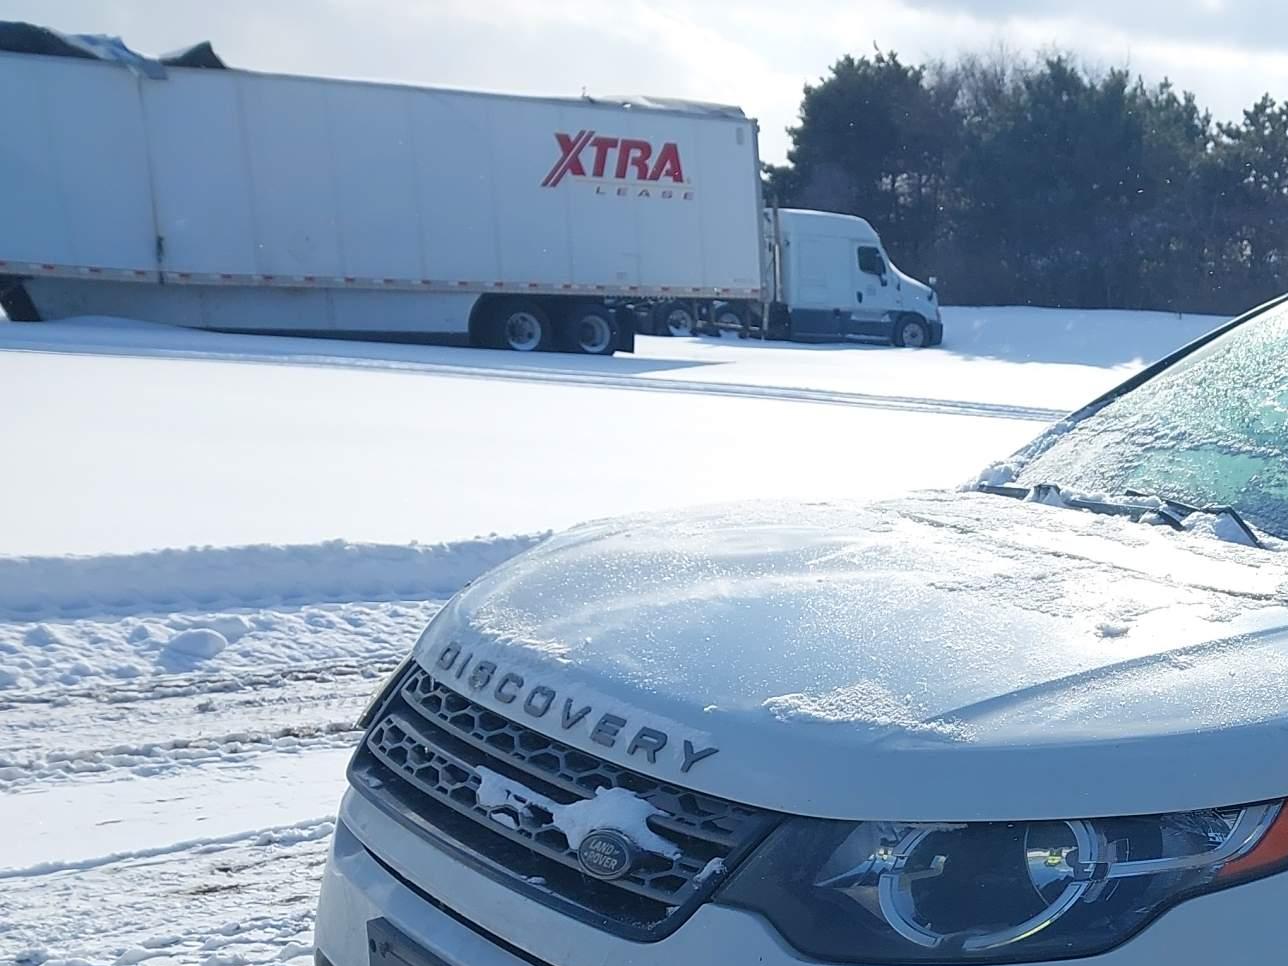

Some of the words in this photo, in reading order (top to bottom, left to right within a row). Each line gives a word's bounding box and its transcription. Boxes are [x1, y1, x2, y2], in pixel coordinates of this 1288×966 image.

[541, 129, 684, 187] XTRA
[595, 186, 695, 201] LEASE
[436, 641, 720, 774] DISCOVERY
[589, 839, 615, 856] LAND
[588, 850, 618, 871] ROVER
